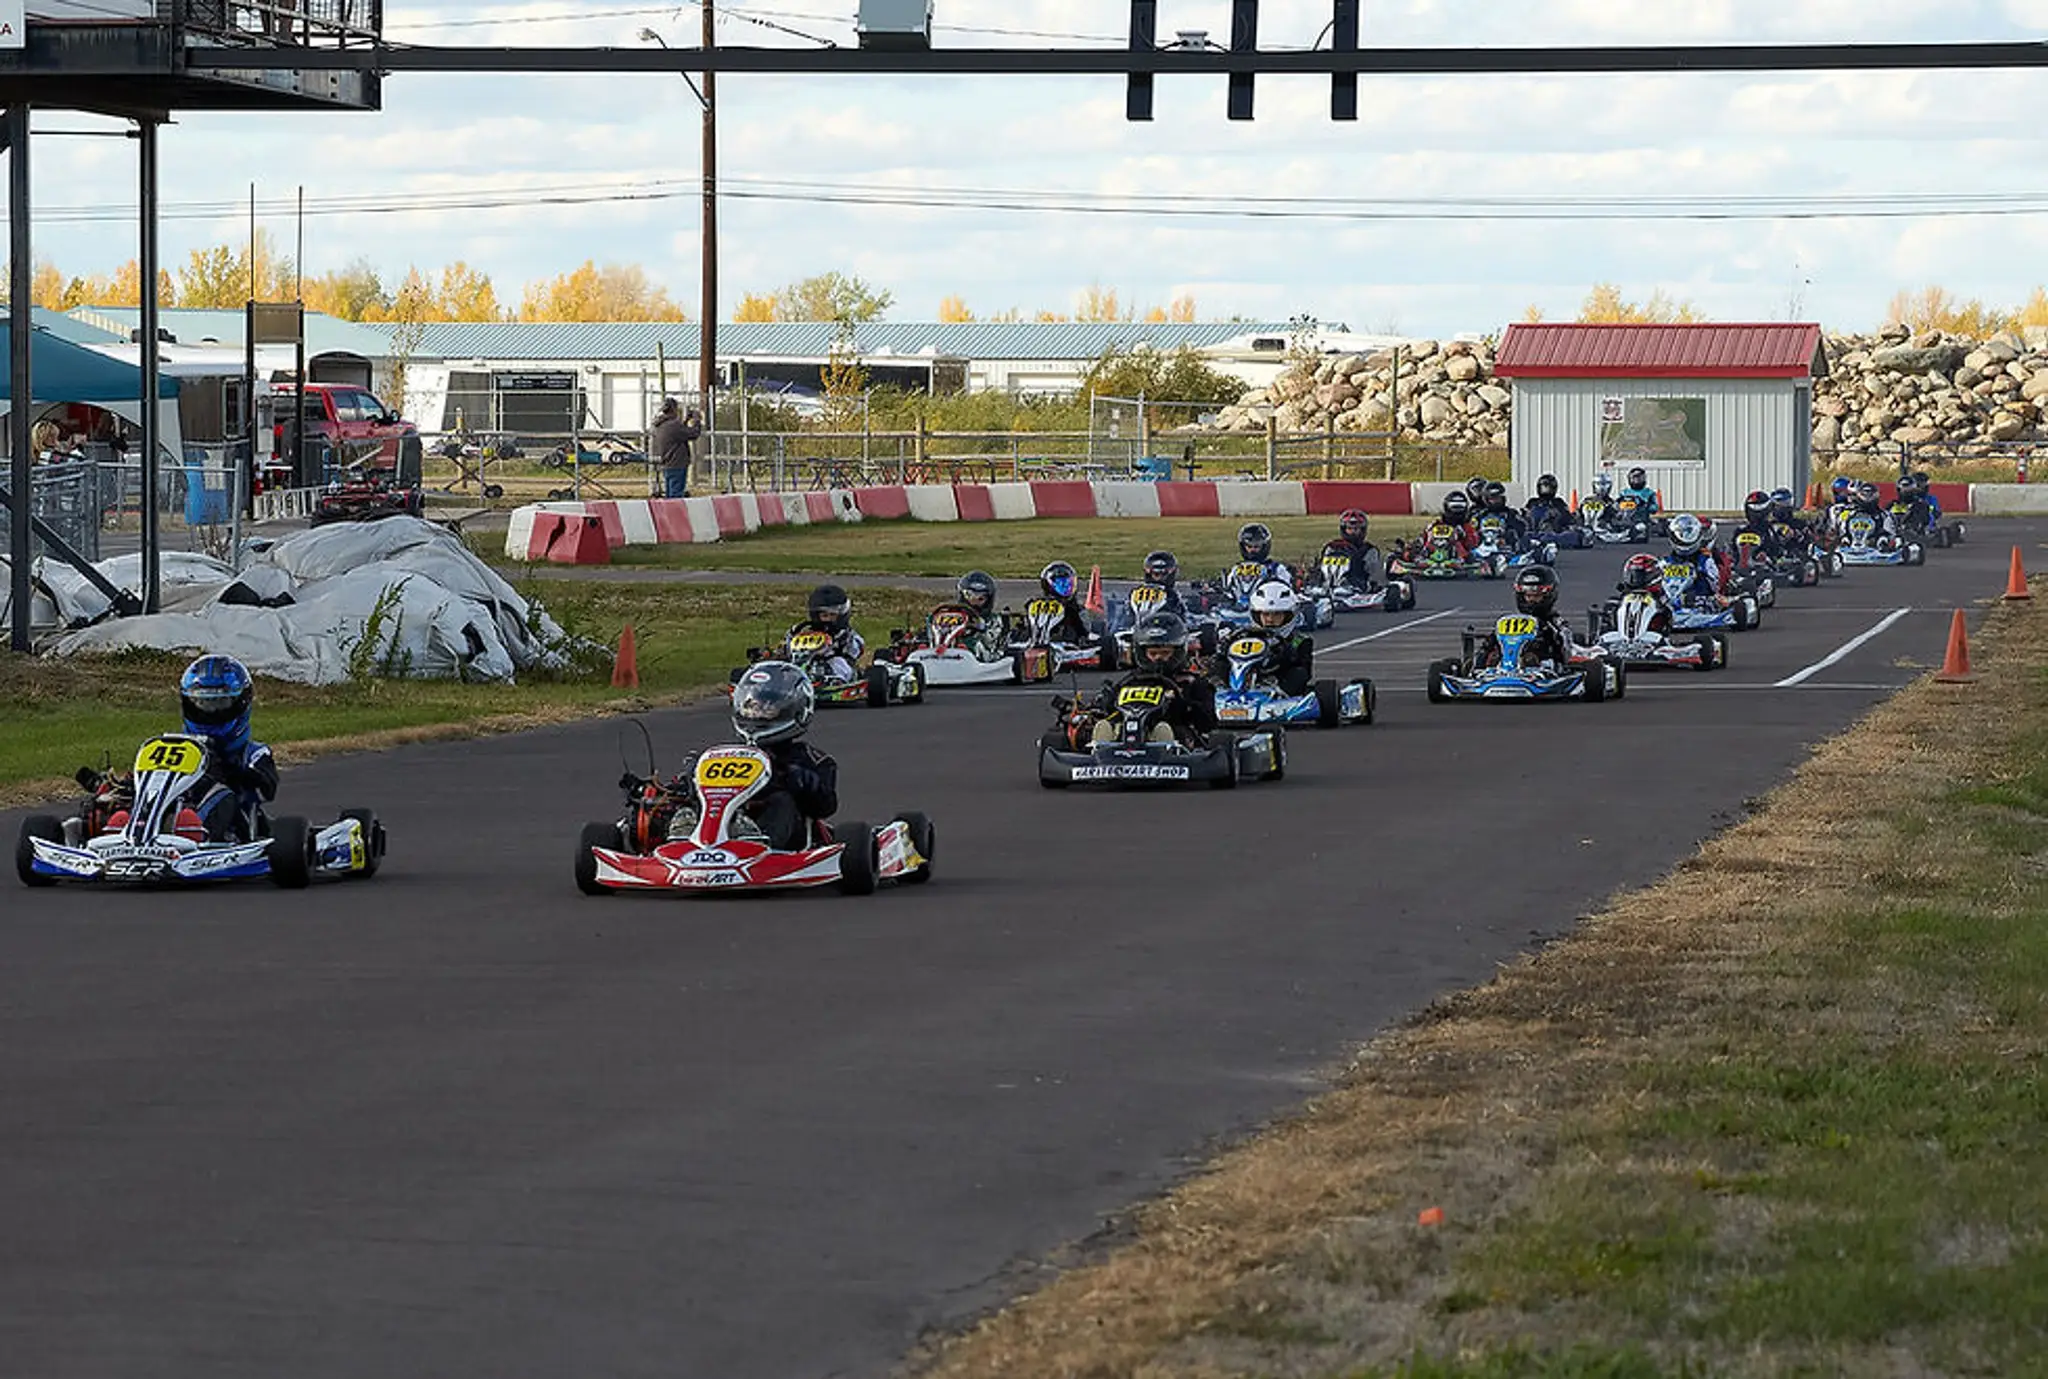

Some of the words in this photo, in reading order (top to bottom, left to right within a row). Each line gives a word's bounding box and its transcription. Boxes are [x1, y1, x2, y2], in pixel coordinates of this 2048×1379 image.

[1505, 618, 1530, 633] 112
[1241, 641, 1253, 655] 9
[149, 746, 187, 766] 45
[705, 762, 754, 779] 662
[105, 861, 166, 876] SCR
